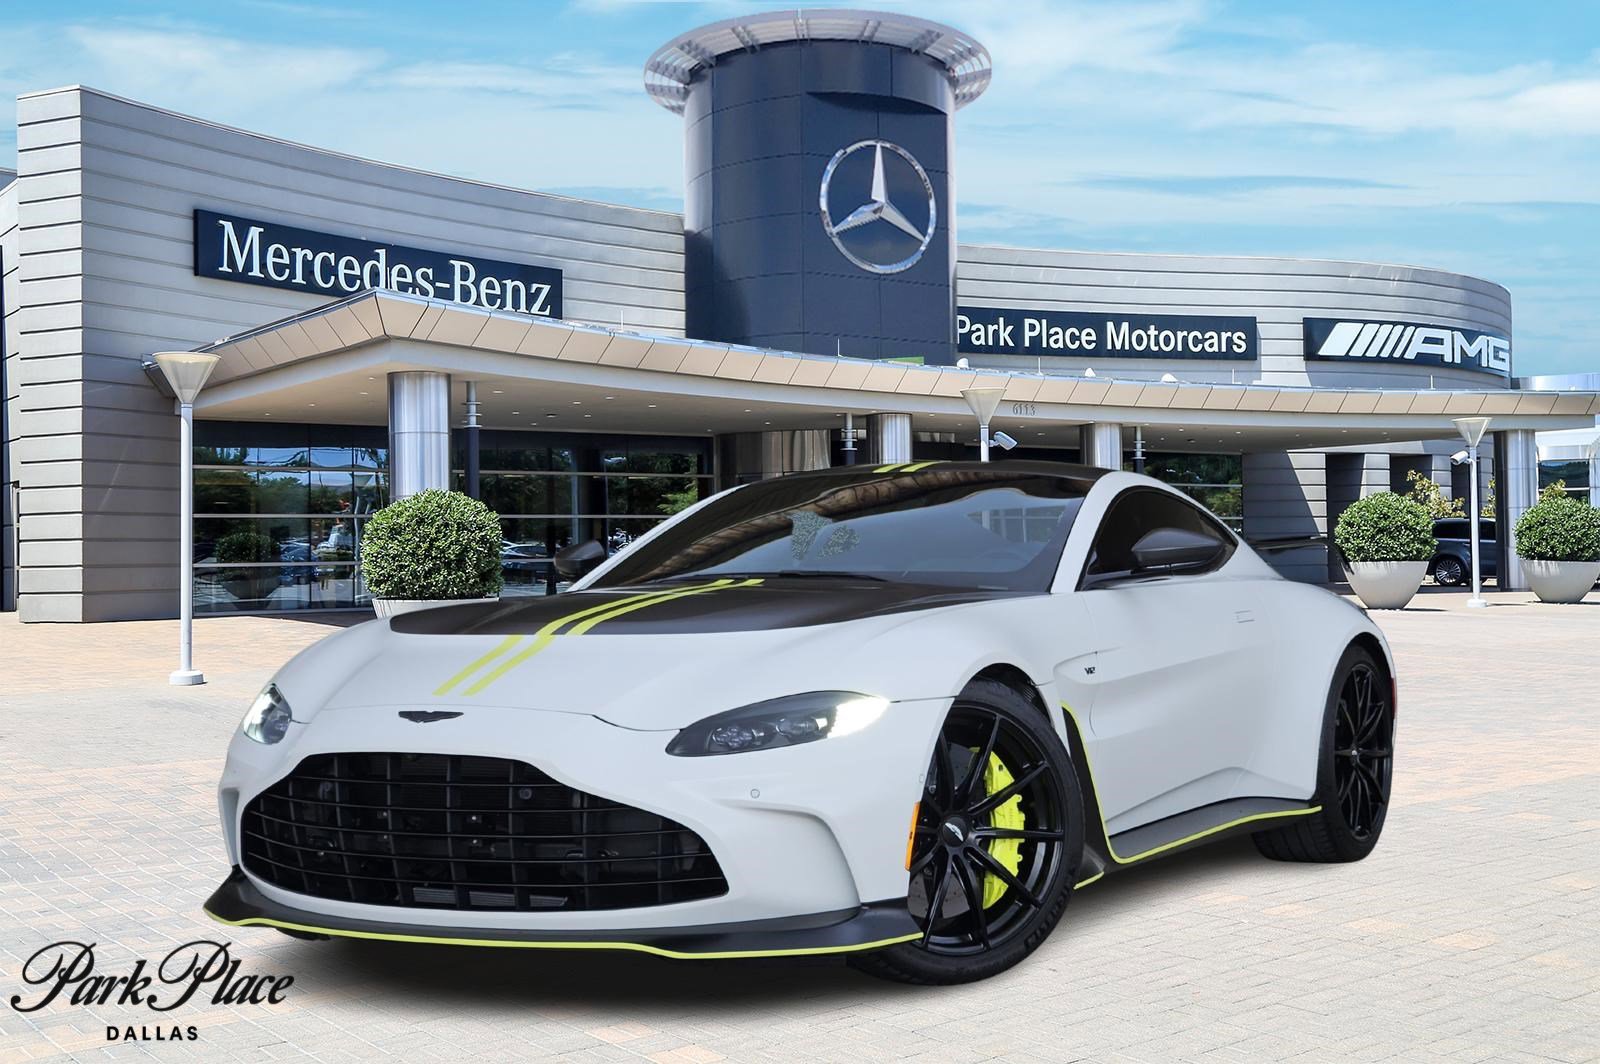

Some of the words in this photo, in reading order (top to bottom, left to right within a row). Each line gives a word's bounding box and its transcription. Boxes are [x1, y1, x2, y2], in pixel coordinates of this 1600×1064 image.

[218, 220, 551, 316] Mercedes-Benz
[957, 315, 1015, 347] Park
[1024, 317, 1097, 350] Place
[1106, 321, 1247, 353] Motorcars
[1403, 327, 1510, 373] AMG
[1012, 402, 1036, 416] 6113
